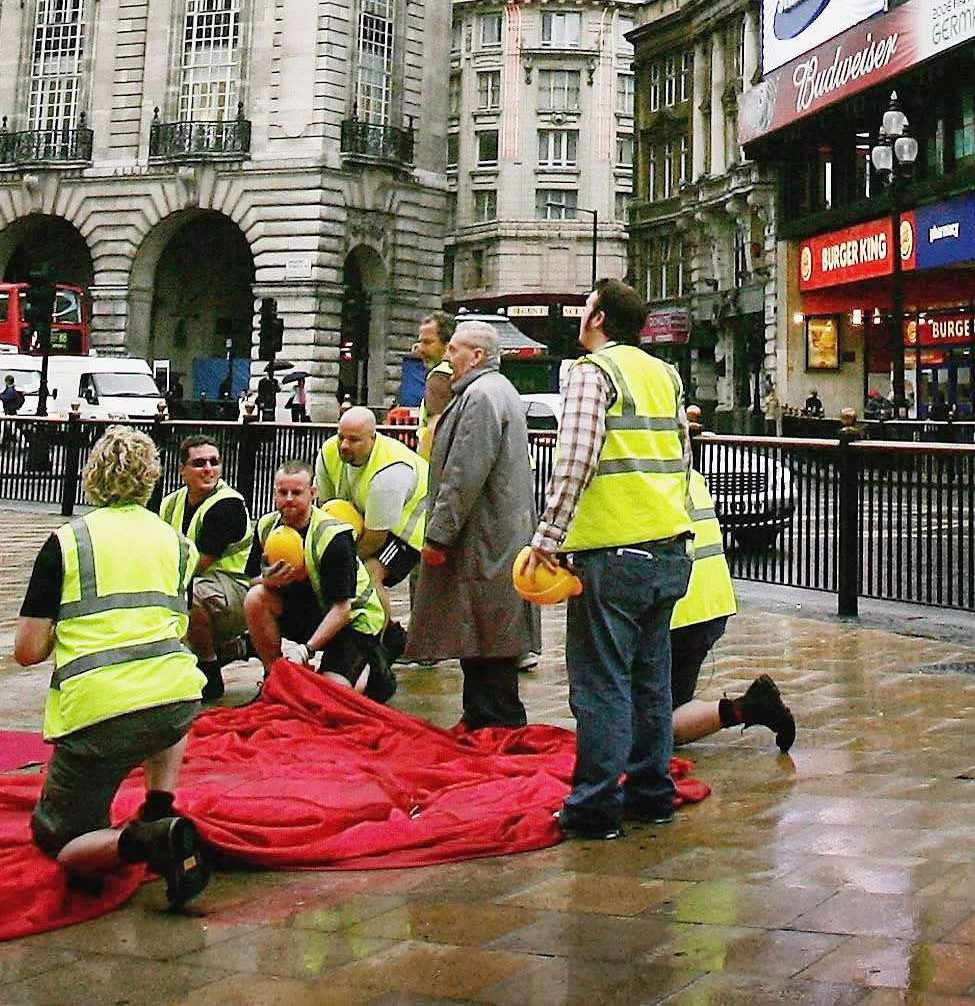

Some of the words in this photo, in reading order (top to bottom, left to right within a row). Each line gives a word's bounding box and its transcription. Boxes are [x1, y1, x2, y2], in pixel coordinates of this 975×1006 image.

[792, 30, 898, 113] Budweiser
[821, 240, 859, 272] BURGER
[860, 232, 887, 264] KING
[932, 319, 975, 339] BURGE
